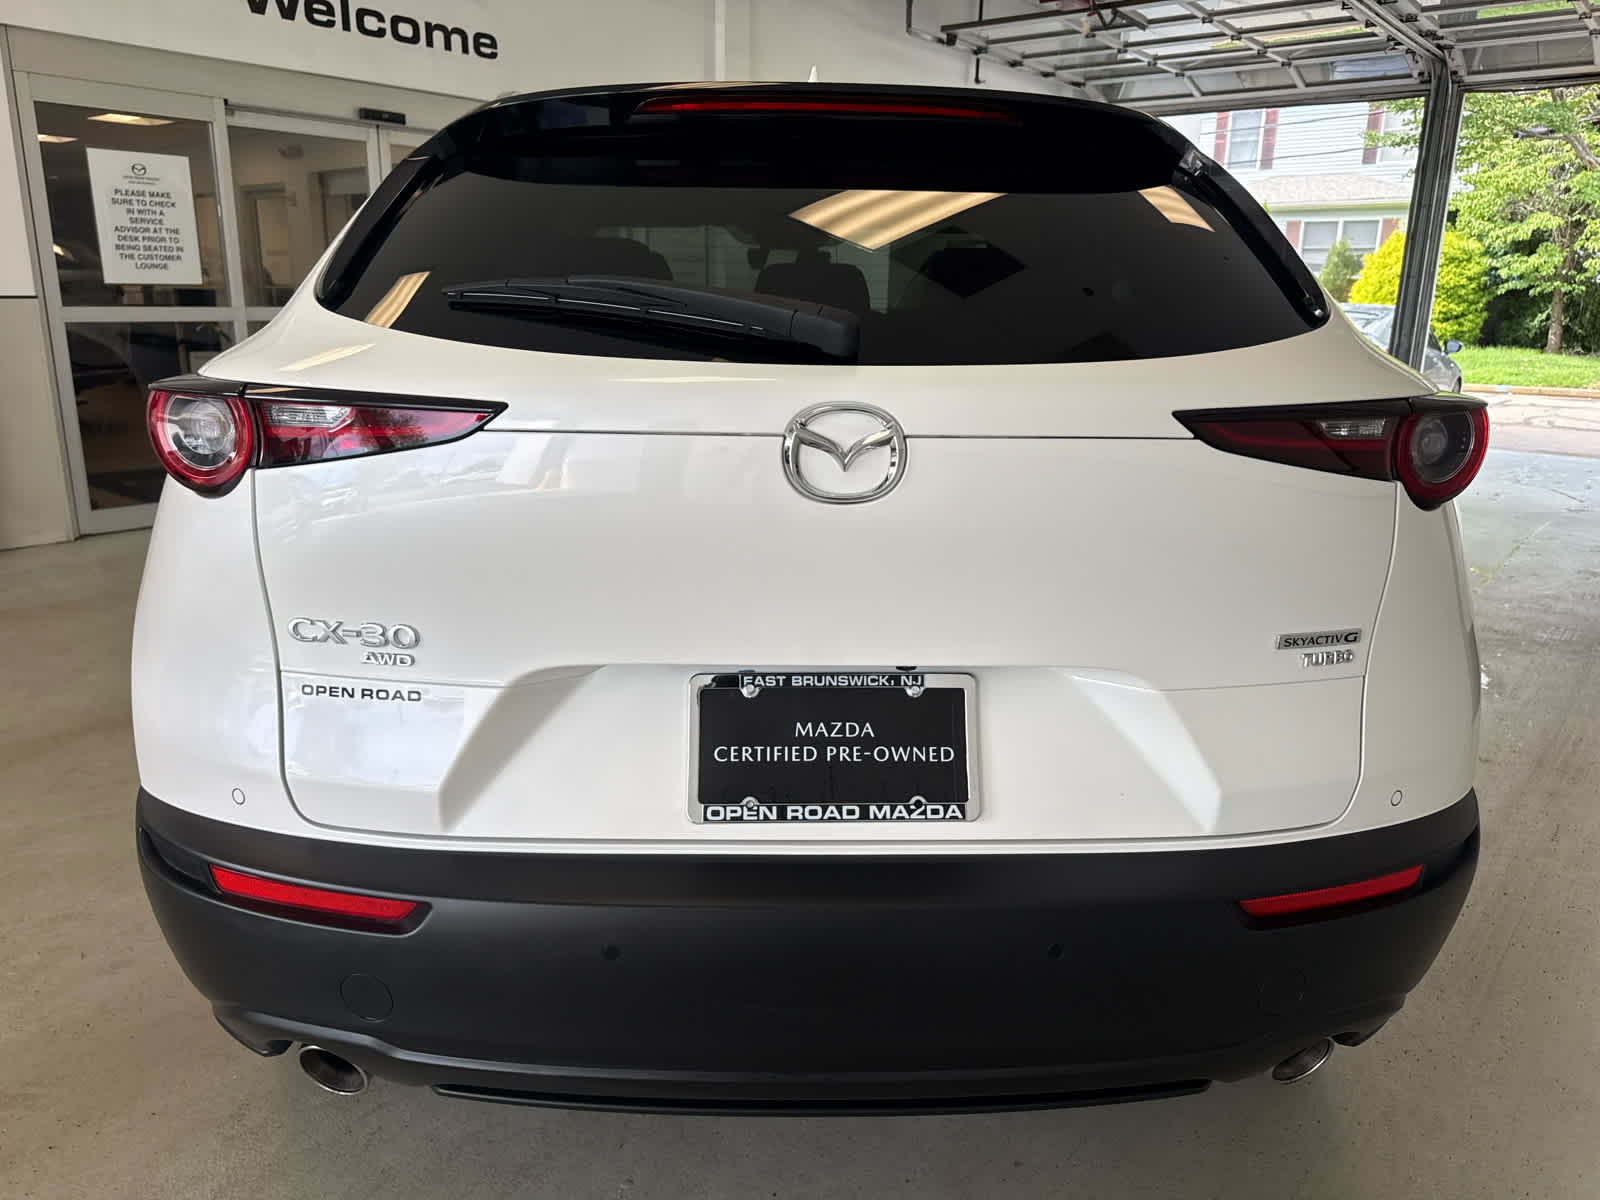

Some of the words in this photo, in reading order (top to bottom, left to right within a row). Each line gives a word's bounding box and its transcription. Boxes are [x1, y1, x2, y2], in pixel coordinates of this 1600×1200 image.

[114, 189, 146, 198] PLEASE
[148, 191, 172, 199] MAKE
[112, 197, 134, 206] SURE
[136, 199, 147, 207] TO
[149, 200, 176, 208] CHECK
[126, 208, 135, 216] IN
[136, 208, 157, 216] WITH
[129, 217, 164, 225] SERVICE
[114, 225, 151, 234] ADVISOR
[153, 227, 162, 235] AT
[165, 227, 180, 235] THE
[117, 234, 139, 242] DESK
[142, 235, 167, 243] PRIOR
[169, 236, 179, 244] TO
[115, 244, 141, 252] BEING
[142, 244, 174, 253] SEATED
[176, 245, 184, 253] IN
[120, 253, 135, 261] THE
[137, 253, 182, 261] CUSTOMER
[135, 262, 168, 270] LOUNGE
[288, 617, 421, 649] CX-30
[361, 651, 415, 666] AWD
[1302, 649, 1353, 667] TURBO
[791, 675, 895, 687] BRUNSWICK,
[900, 675, 922, 687] NJ
[301, 684, 355, 699] OPEN
[361, 688, 422, 702] ROAD
[795, 722, 875, 738] MAZDA
[714, 746, 818, 763] CERTIFIED
[826, 746, 955, 763] PRE-OWNED
[706, 805, 777, 820] OPEN
[786, 805, 860, 820] ROAD
[868, 804, 963, 819] MAZDA
